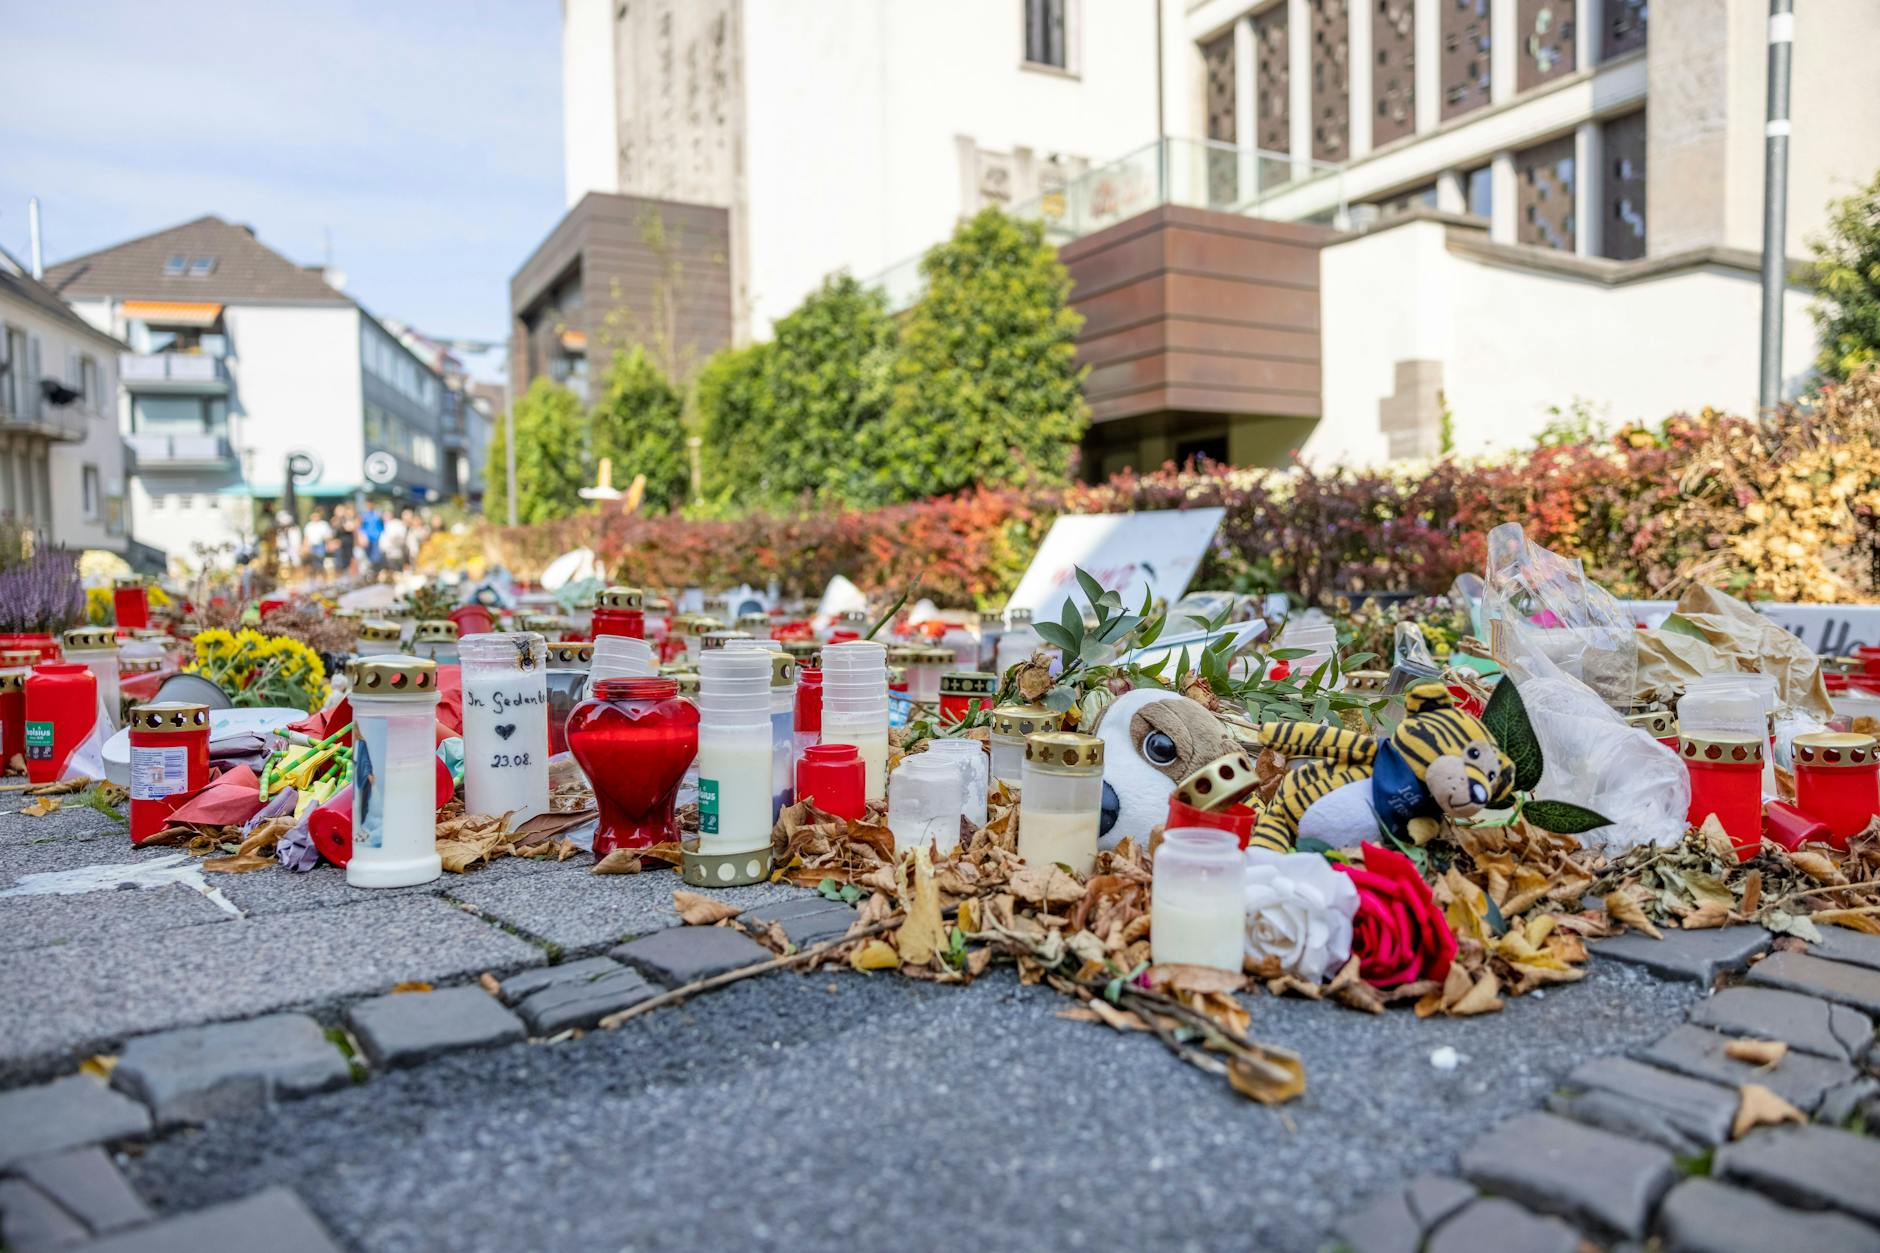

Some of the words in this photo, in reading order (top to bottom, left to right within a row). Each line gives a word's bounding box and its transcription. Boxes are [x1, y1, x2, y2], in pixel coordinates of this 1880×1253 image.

[467, 691, 485, 707] In
[491, 753, 532, 768] 23.08.
[1397, 785, 1422, 806] Ich
